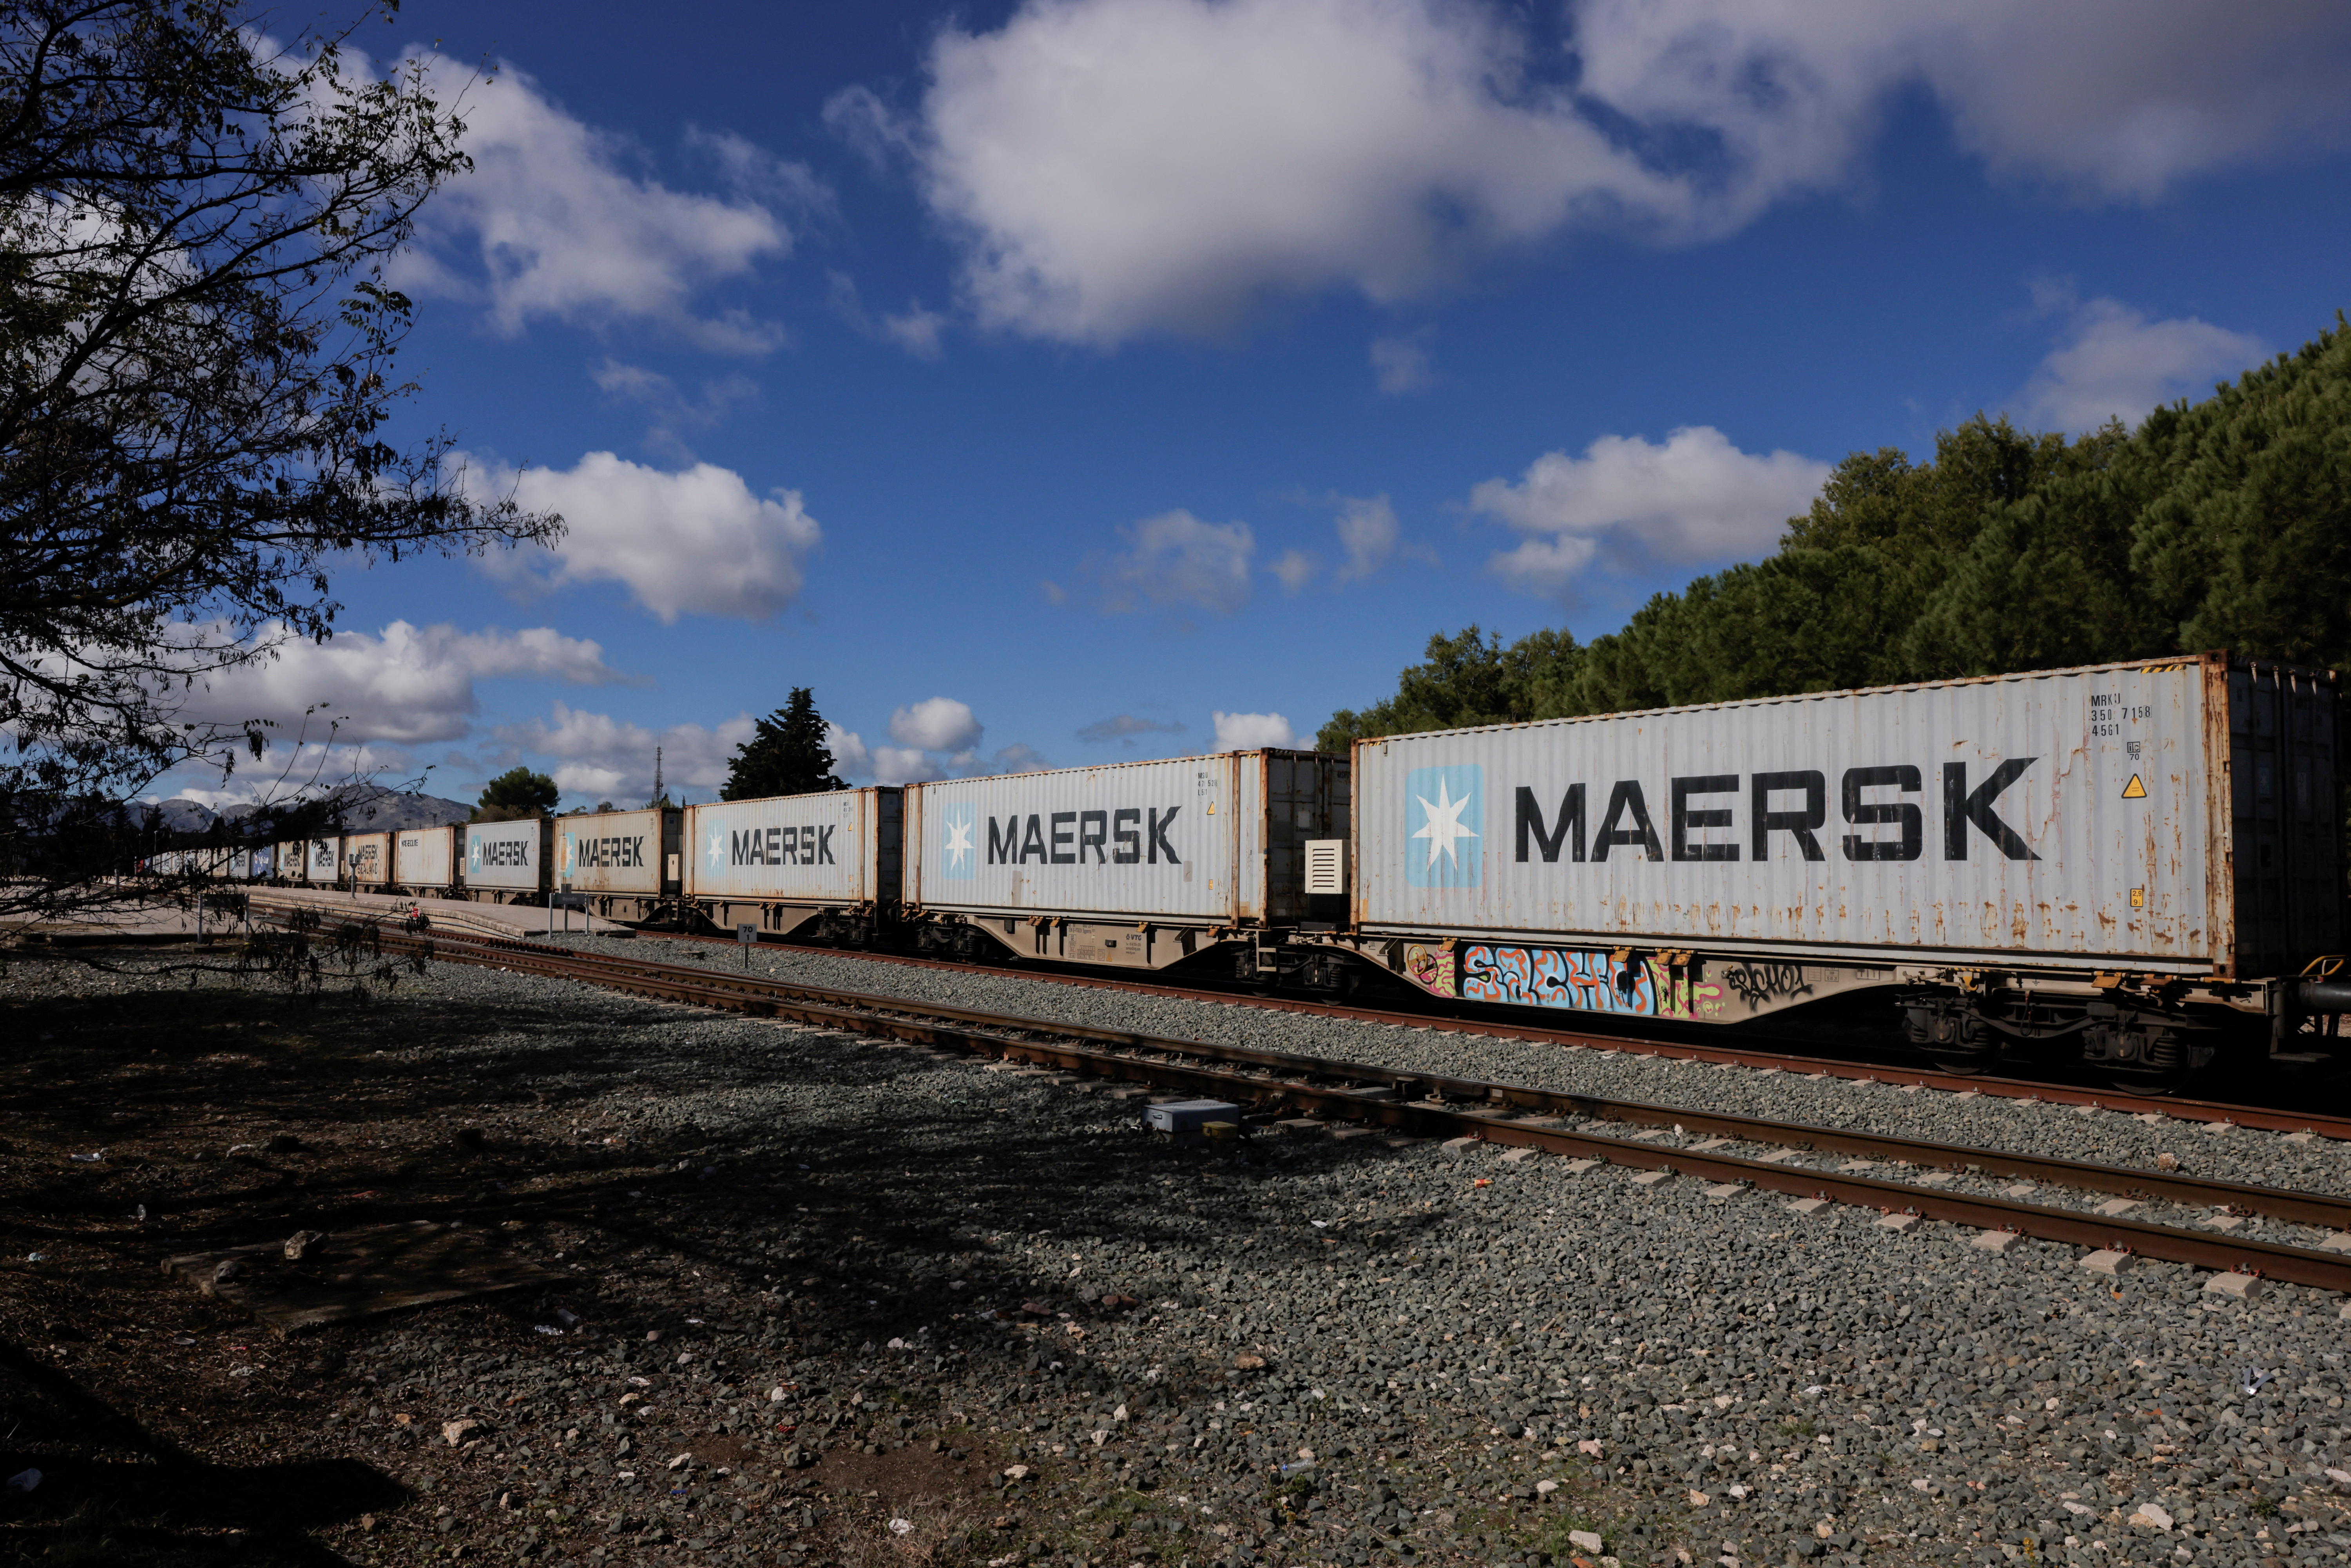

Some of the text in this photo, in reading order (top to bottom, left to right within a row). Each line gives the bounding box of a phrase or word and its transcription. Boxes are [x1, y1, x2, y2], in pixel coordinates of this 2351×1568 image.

[2091, 693, 2120, 706] MRKU
[2092, 724, 2119, 736] 45G1
[1516, 757, 2043, 863] MAERSK
[732, 824, 836, 865] MAERSK
[988, 806, 1182, 864] MAERSK
[483, 840, 529, 866] MAERSK
[579, 836, 644, 867] MAERSK
